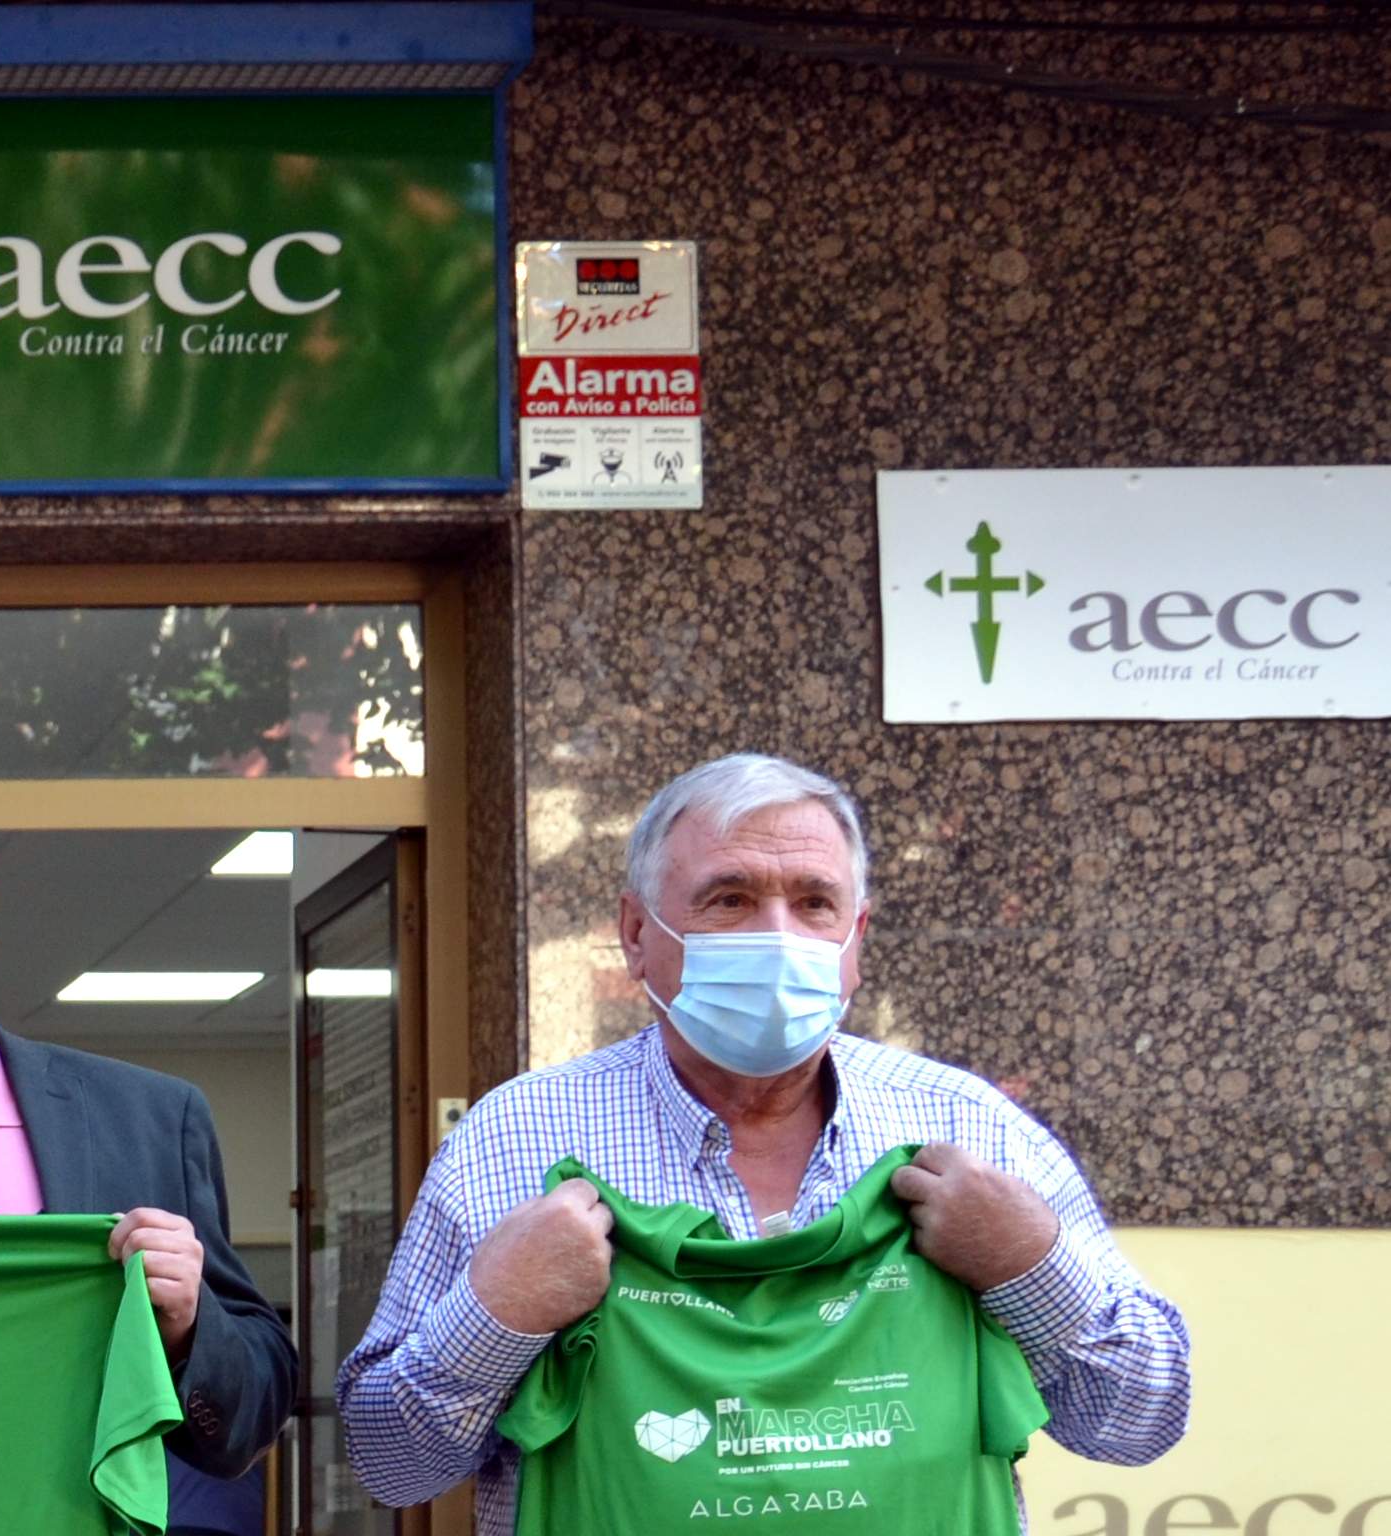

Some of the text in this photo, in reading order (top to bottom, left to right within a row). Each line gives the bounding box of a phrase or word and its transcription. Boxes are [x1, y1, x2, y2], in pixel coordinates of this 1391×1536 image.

[553, 292, 672, 342] Direct
[19, 323, 289, 356] Contra el Cáncer
[526, 359, 695, 396] Alarma
[526, 397, 696, 415] con Aviso a Policía
[1069, 587, 1361, 653] aecc
[1111, 657, 1322, 682] Contra el Cáncer
[715, 1397, 741, 1415] EN
[716, 1401, 916, 1441] MARCHA
[717, 1429, 892, 1458] PUERTOLLANO
[719, 1467, 738, 1475] POR
[813, 1459, 850, 1469] CÁNCER
[689, 1489, 868, 1519] ALGARABA
